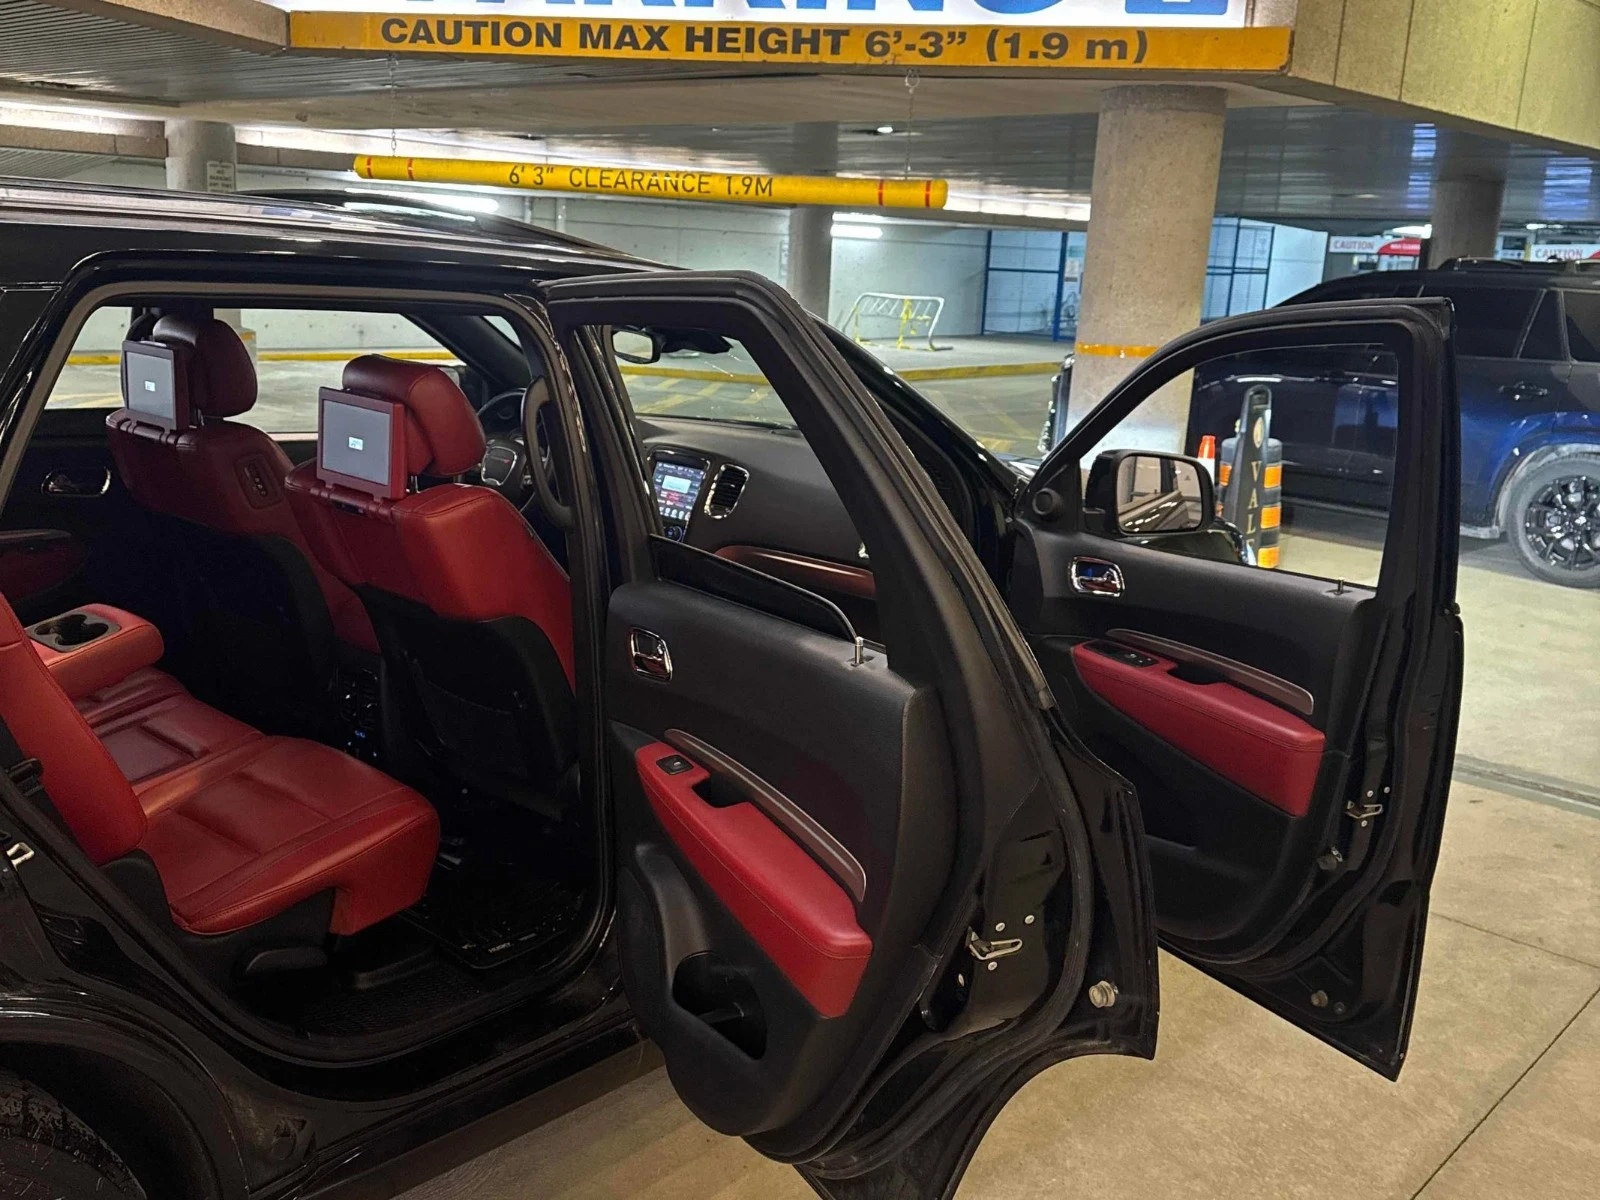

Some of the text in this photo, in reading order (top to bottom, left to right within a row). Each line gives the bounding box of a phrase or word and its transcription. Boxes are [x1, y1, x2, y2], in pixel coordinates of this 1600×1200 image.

[381, 18, 562, 47] CAUTION
[579, 23, 669, 51] MAX
[685, 27, 851, 55] HEIGHT
[986, 29, 1069, 61] (1.9
[1086, 31, 1148, 63] m)
[569, 168, 712, 194] CLEARANCE
[725, 175, 773, 197] 1.9M
[1333, 240, 1376, 251] CAUTION
